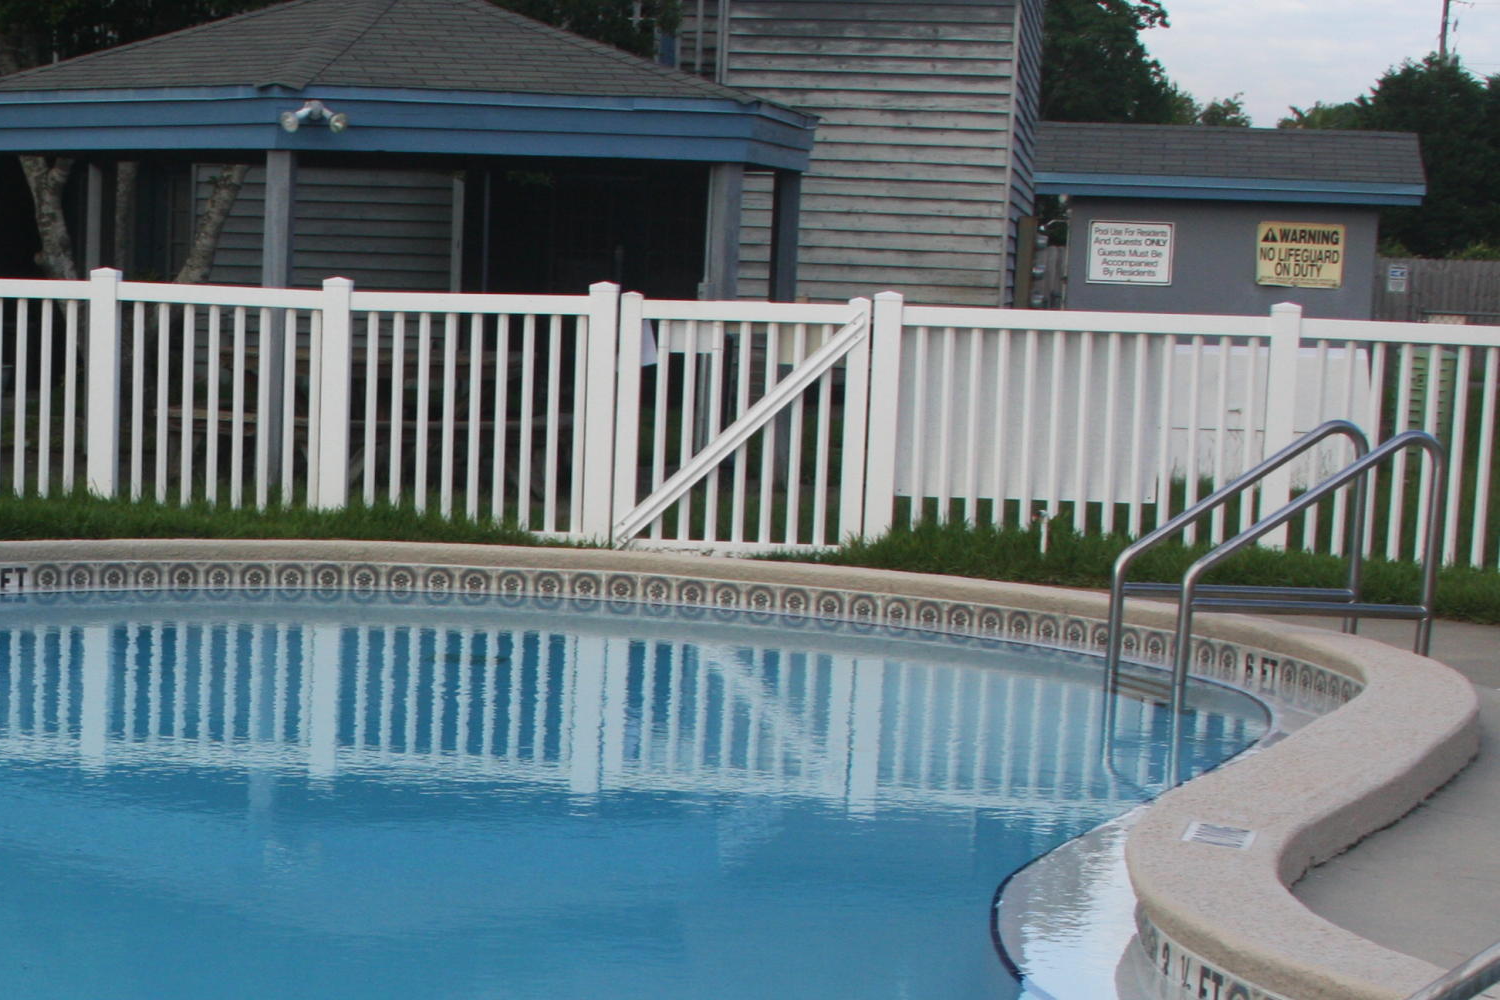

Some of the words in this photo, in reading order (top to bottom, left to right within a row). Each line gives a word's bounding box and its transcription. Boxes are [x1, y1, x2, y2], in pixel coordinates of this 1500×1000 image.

[1094, 227, 1109, 236] Pool
[1110, 227, 1123, 236] Use
[1124, 227, 1135, 236] For
[1136, 228, 1168, 237] Residents
[1279, 228, 1340, 245] WARNING
[1094, 237, 1111, 245] And
[1113, 237, 1142, 246] Guests
[1144, 238, 1169, 246] ONLY
[1097, 248, 1126, 257] Guests
[1128, 249, 1149, 257] Must
[1151, 250, 1163, 258] Be
[1260, 247, 1276, 262] NO
[1278, 248, 1340, 264] LIFEGUARD
[1101, 258, 1159, 268] Accompanied
[1102, 268, 1114, 277] By
[1116, 268, 1156, 277] Residents
[1274, 262, 1291, 276] ON
[1293, 263, 1323, 277] DUTY
[0, 567, 28, 589] FT
[1244, 653, 1255, 676] 6
[1260, 657, 1278, 681] FT
